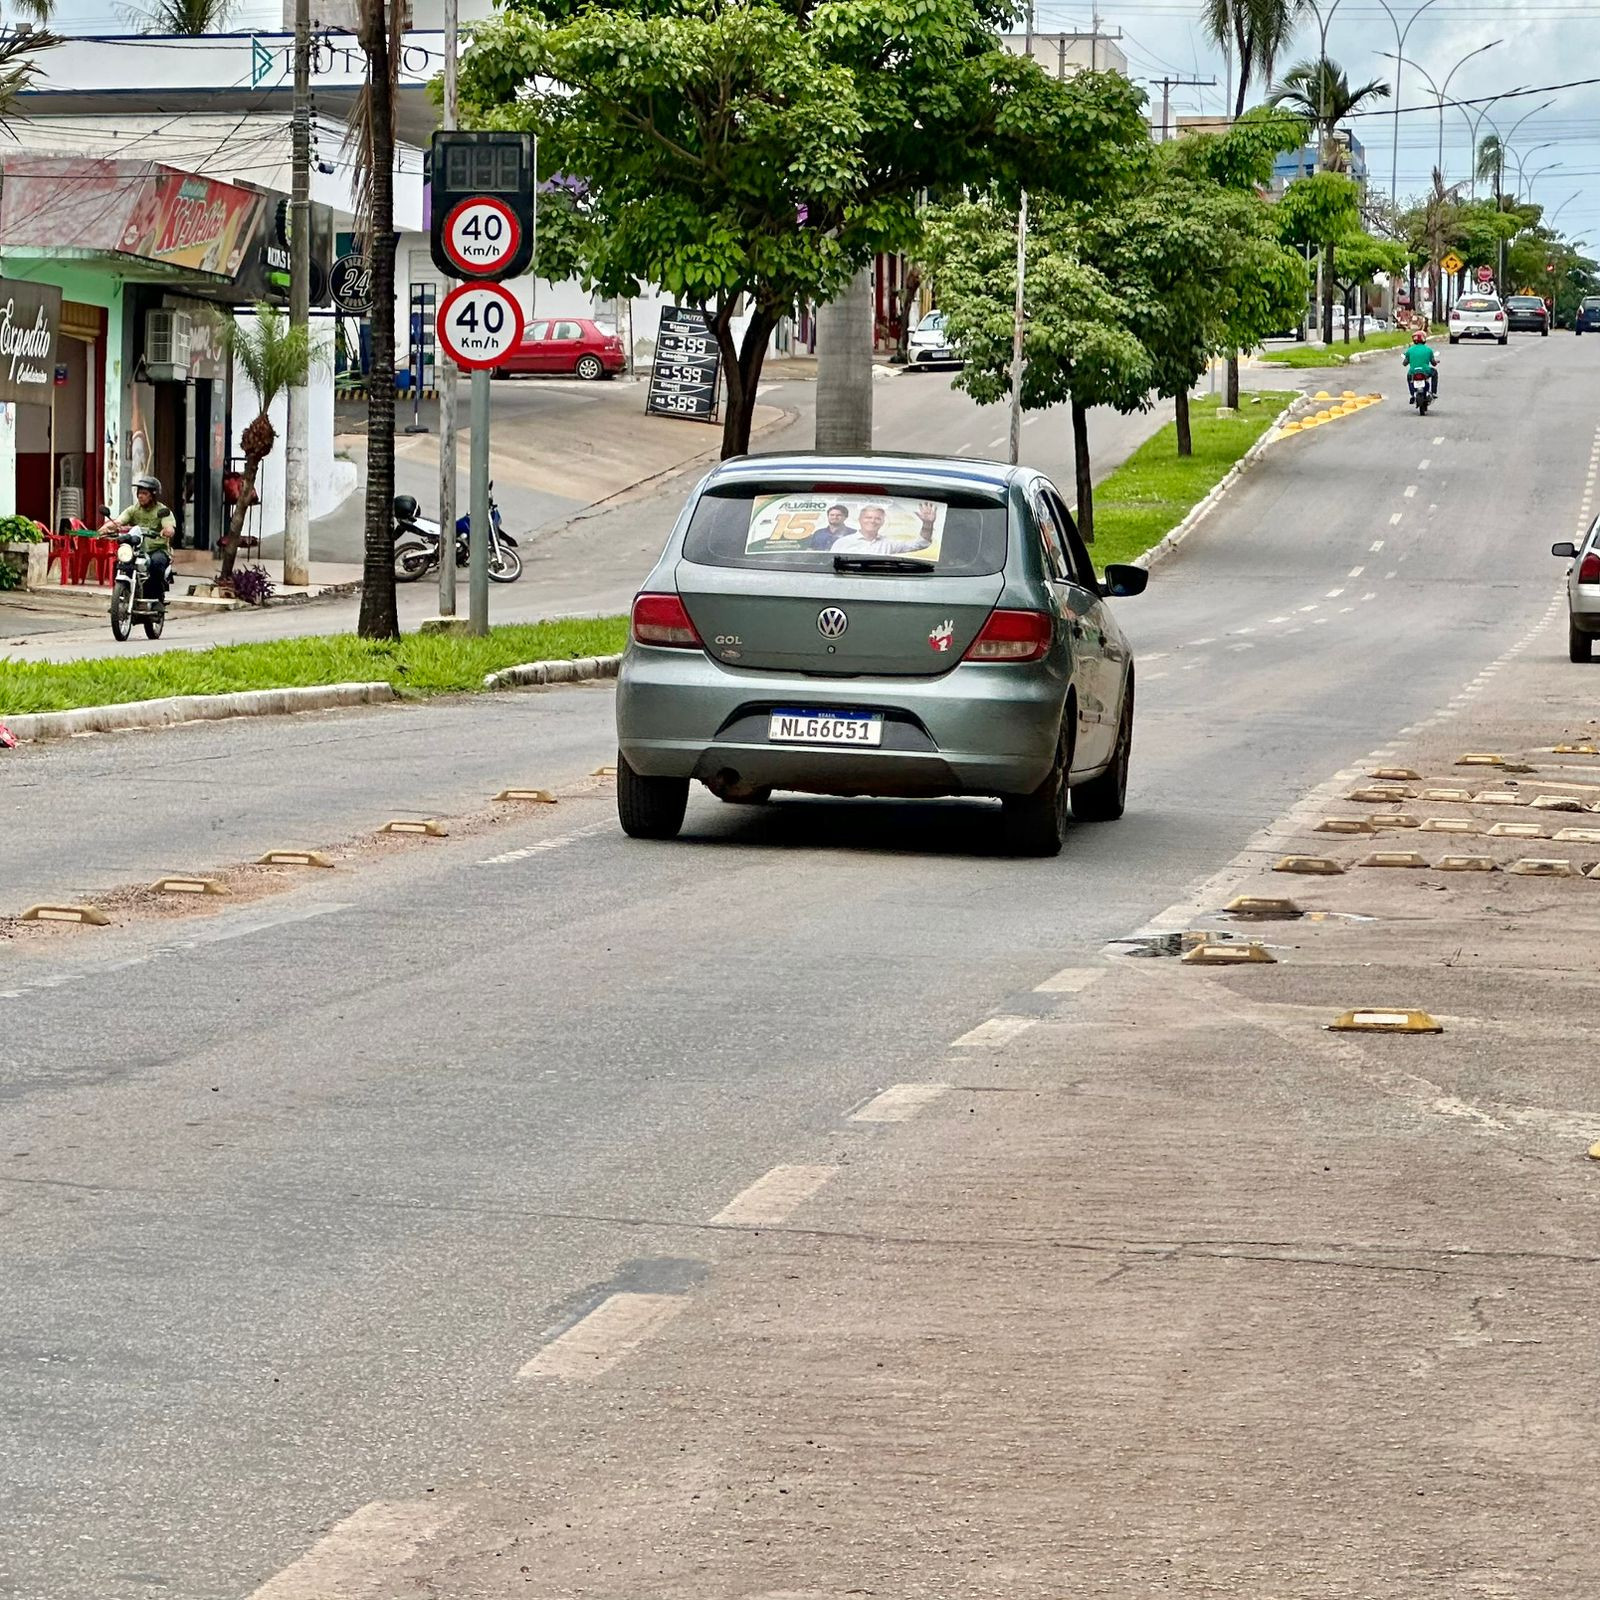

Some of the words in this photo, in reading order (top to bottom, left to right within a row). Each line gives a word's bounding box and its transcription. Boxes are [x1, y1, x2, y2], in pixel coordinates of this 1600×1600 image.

[462, 214, 502, 241] 40
[463, 244, 500, 256] Km/h
[340, 268, 372, 297] 24
[456, 301, 504, 334] 40
[461, 337, 499, 350] Km/h
[769, 512, 820, 540] 15
[715, 635, 743, 645] GOL
[780, 718, 869, 741] NLG6C51
